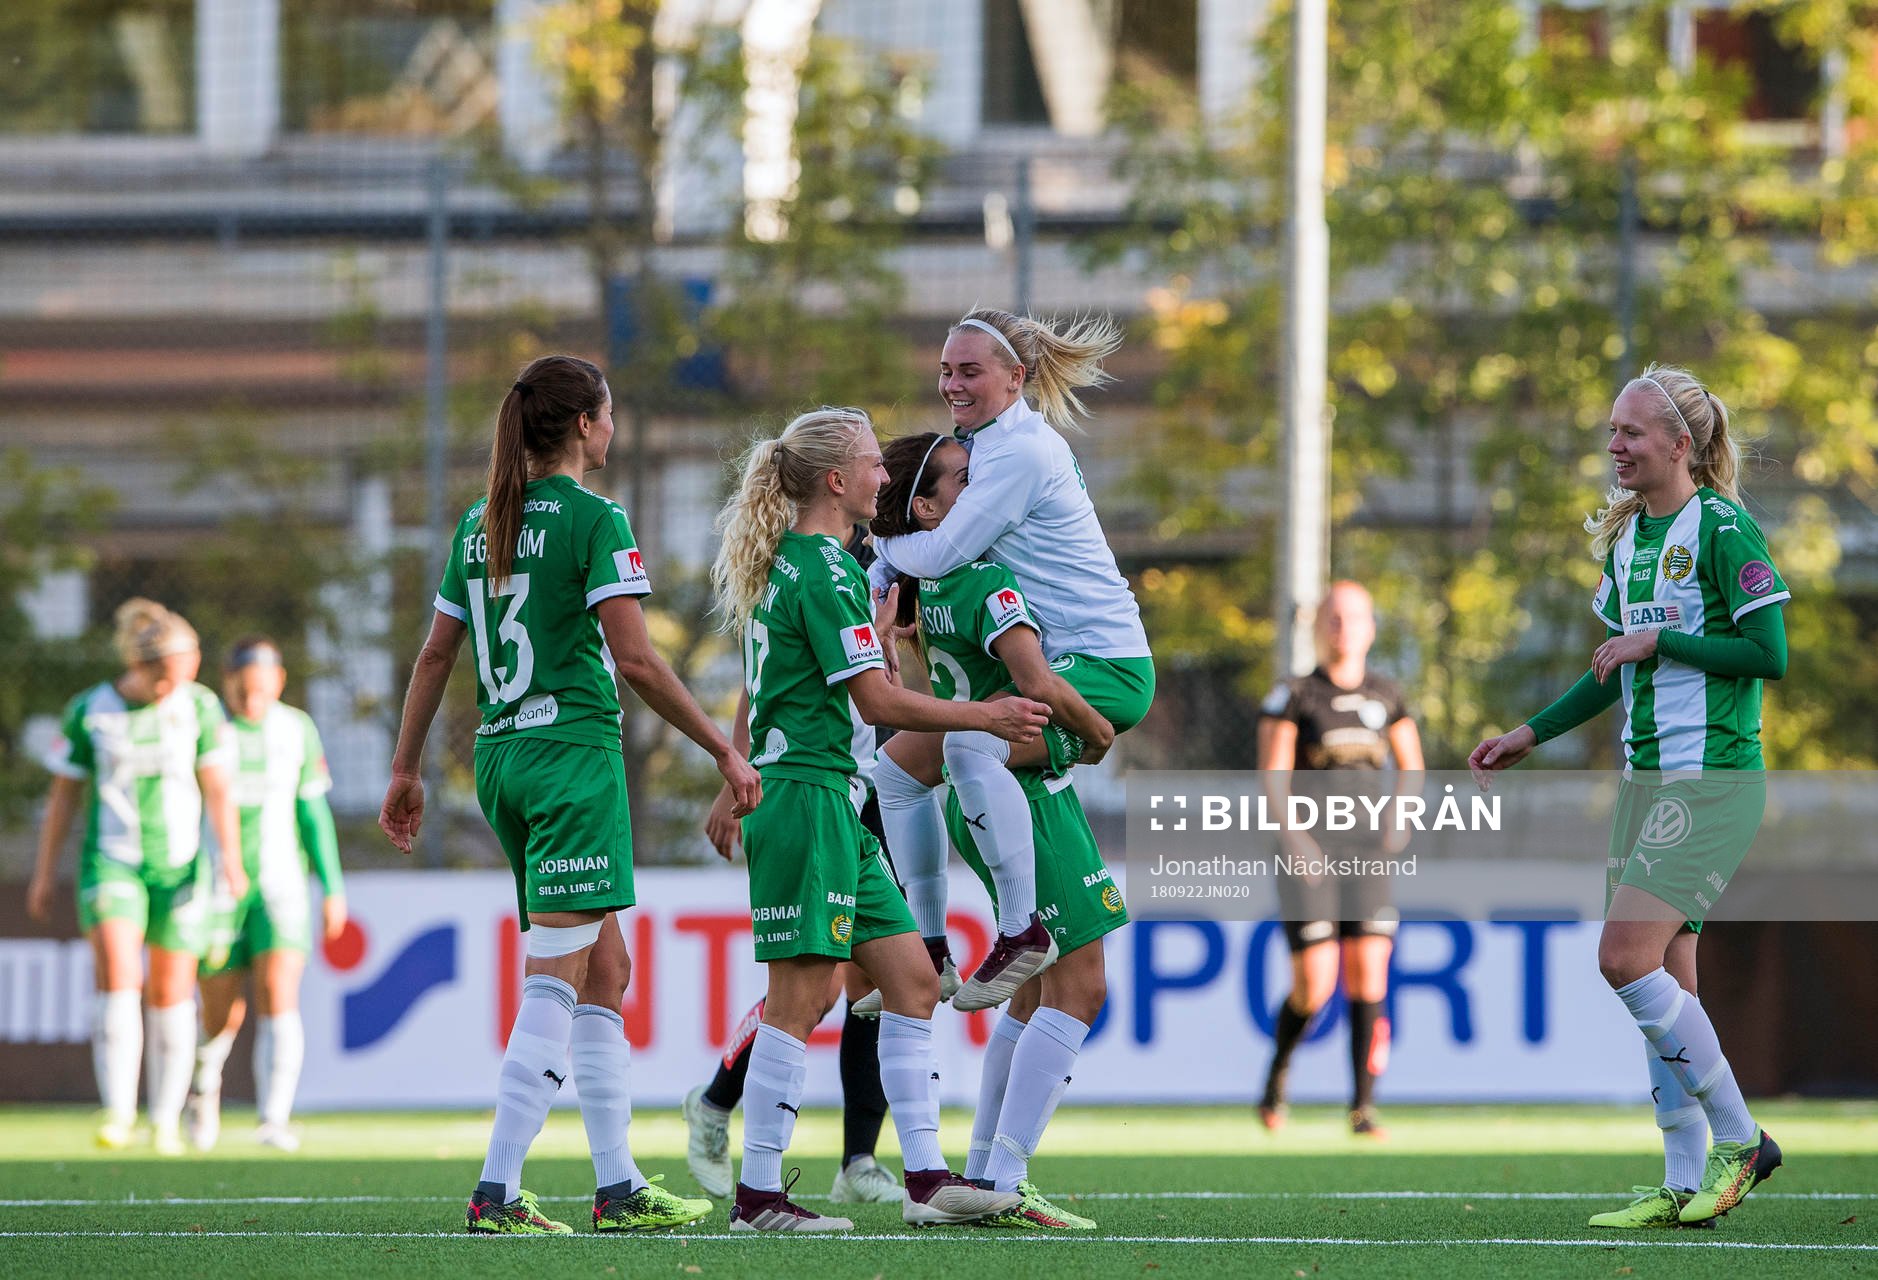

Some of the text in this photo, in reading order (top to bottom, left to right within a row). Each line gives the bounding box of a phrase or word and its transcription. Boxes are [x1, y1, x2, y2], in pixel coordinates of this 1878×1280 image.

[463, 523, 546, 565] TEGÖM
[1633, 567, 1652, 582] TELE2
[466, 572, 535, 705] 13
[518, 703, 553, 722] bank
[538, 855, 609, 874] JOBMAN
[1083, 868, 1110, 888] BAJE
[538, 882, 596, 896] SILJA LINE
[752, 903, 802, 922] OBMAN
[767, 931, 792, 943] LINE
[498, 908, 1583, 1050] INTRPORT
